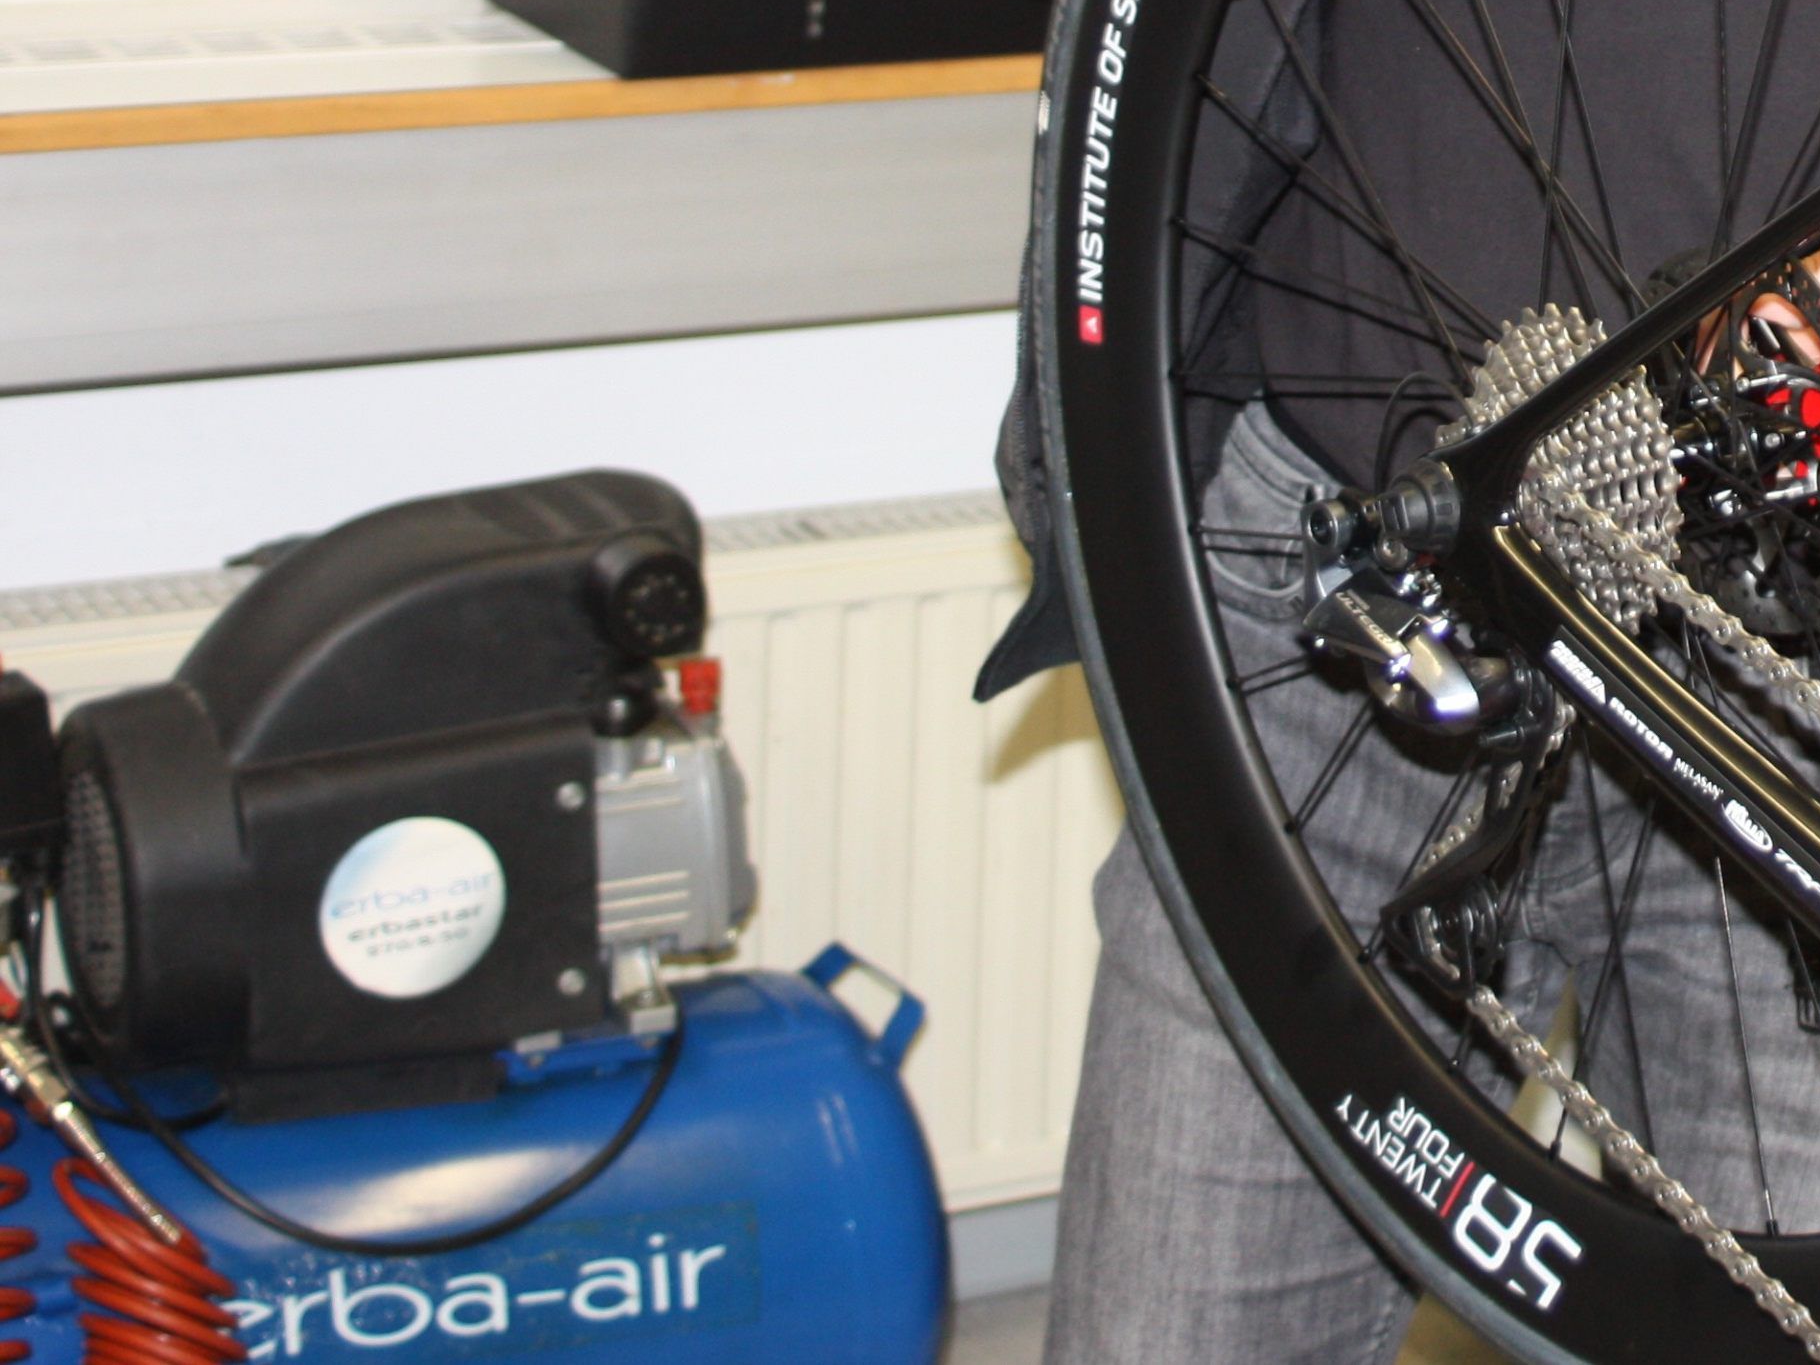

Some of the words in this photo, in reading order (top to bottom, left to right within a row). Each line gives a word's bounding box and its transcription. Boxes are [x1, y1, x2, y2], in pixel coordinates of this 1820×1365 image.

[1078, 87, 1118, 303] INSTITUTE
[1098, 22, 1127, 85] OF
[1609, 696, 1674, 761] ROTOR
[1334, 1093, 1444, 1209] TWENTY
[1386, 1095, 1466, 1179] FOUR
[1453, 1173, 1583, 1310] 58
[219, 1235, 727, 1360] erba-air
